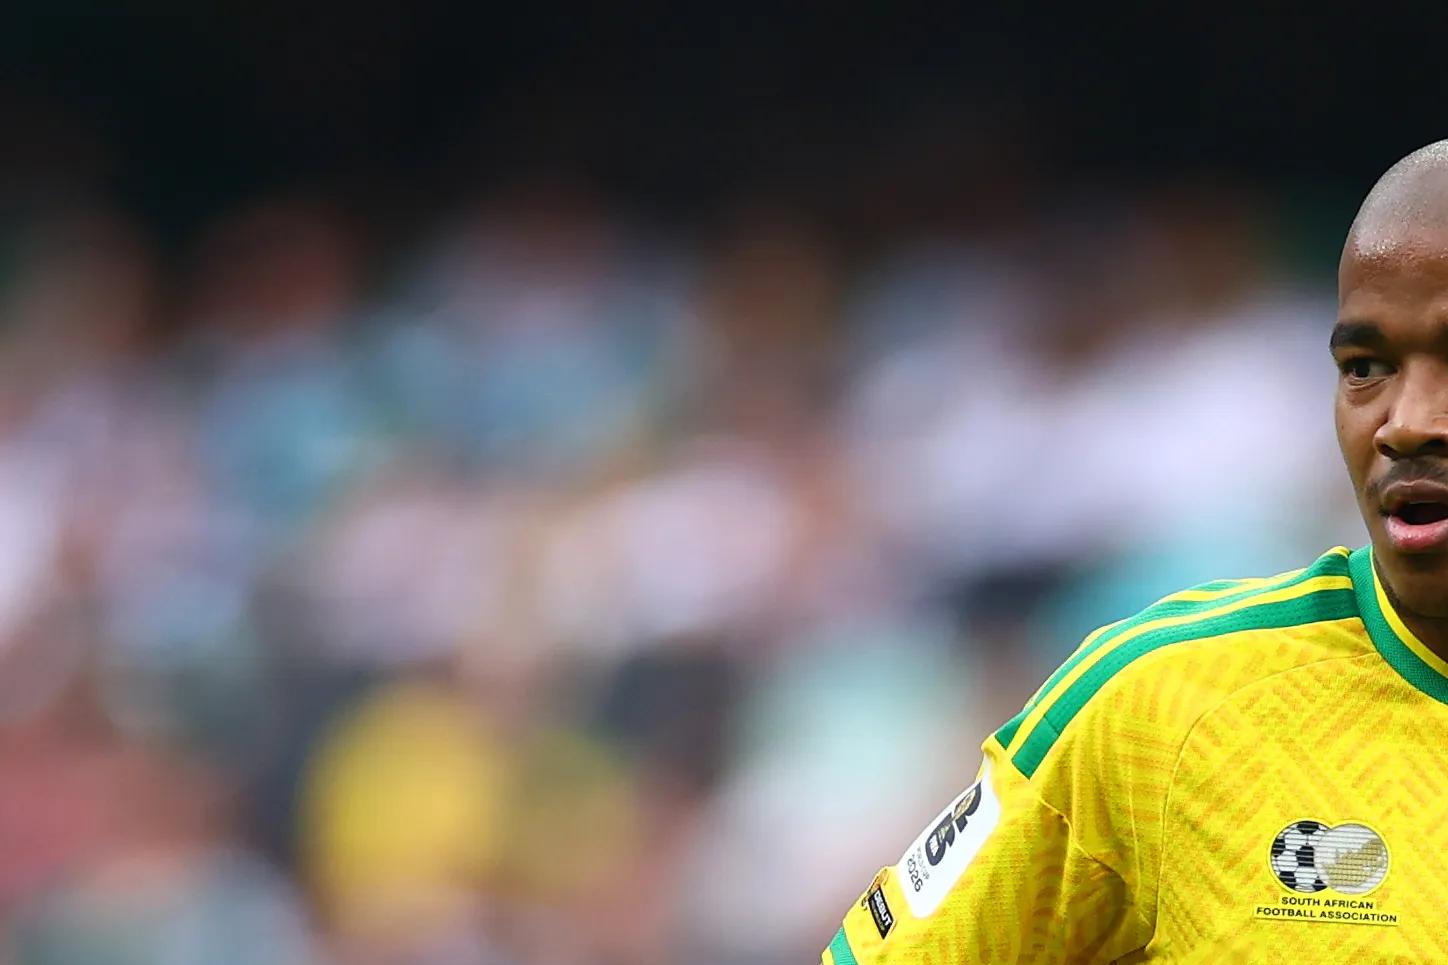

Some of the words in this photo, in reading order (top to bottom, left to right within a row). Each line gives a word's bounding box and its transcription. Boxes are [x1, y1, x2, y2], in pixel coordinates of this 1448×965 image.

[907, 854, 924, 892] 2026
[1281, 896, 1321, 907] SOUTH
[1323, 899, 1374, 910] AFRICAN
[1256, 906, 1317, 918] FOOTBALL
[1319, 910, 1397, 923] ASSOCIATION
